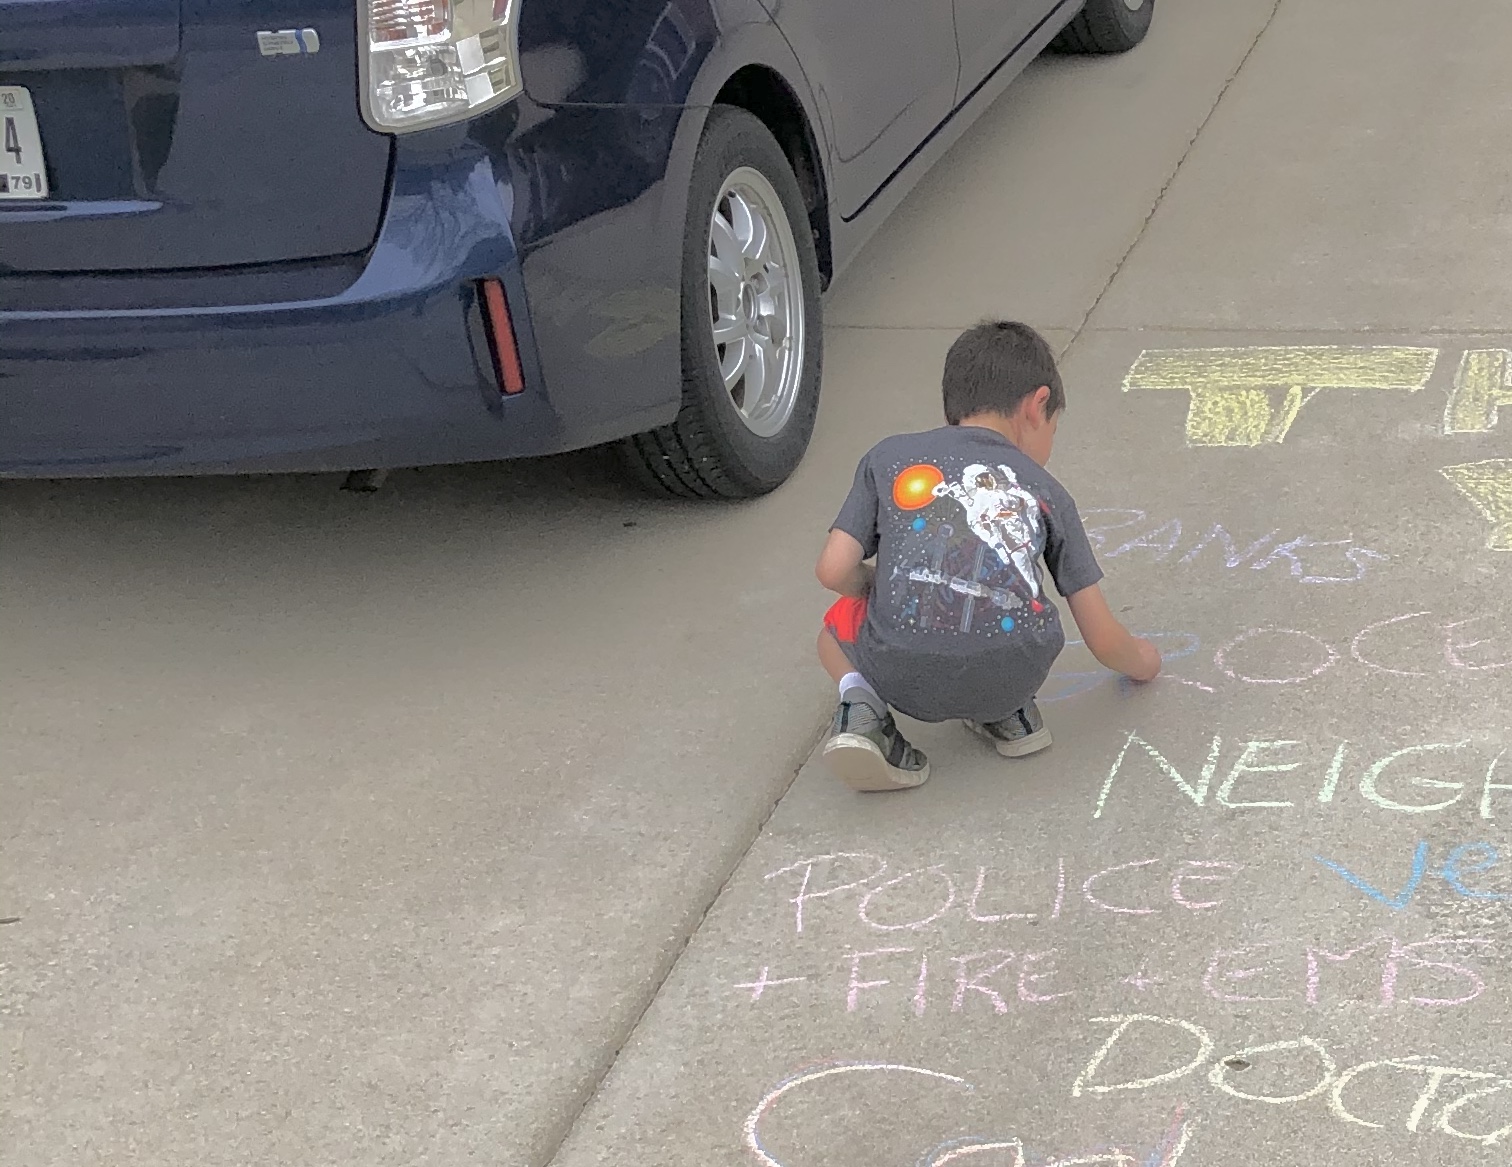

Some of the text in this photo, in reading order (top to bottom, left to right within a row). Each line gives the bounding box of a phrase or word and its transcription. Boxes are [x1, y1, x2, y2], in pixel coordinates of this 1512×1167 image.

[10, 175, 33, 190] 79
[764, 851, 1240, 932] POLICE
[846, 946, 1067, 1013] FIRE
[1200, 937, 1495, 1007] EMS
